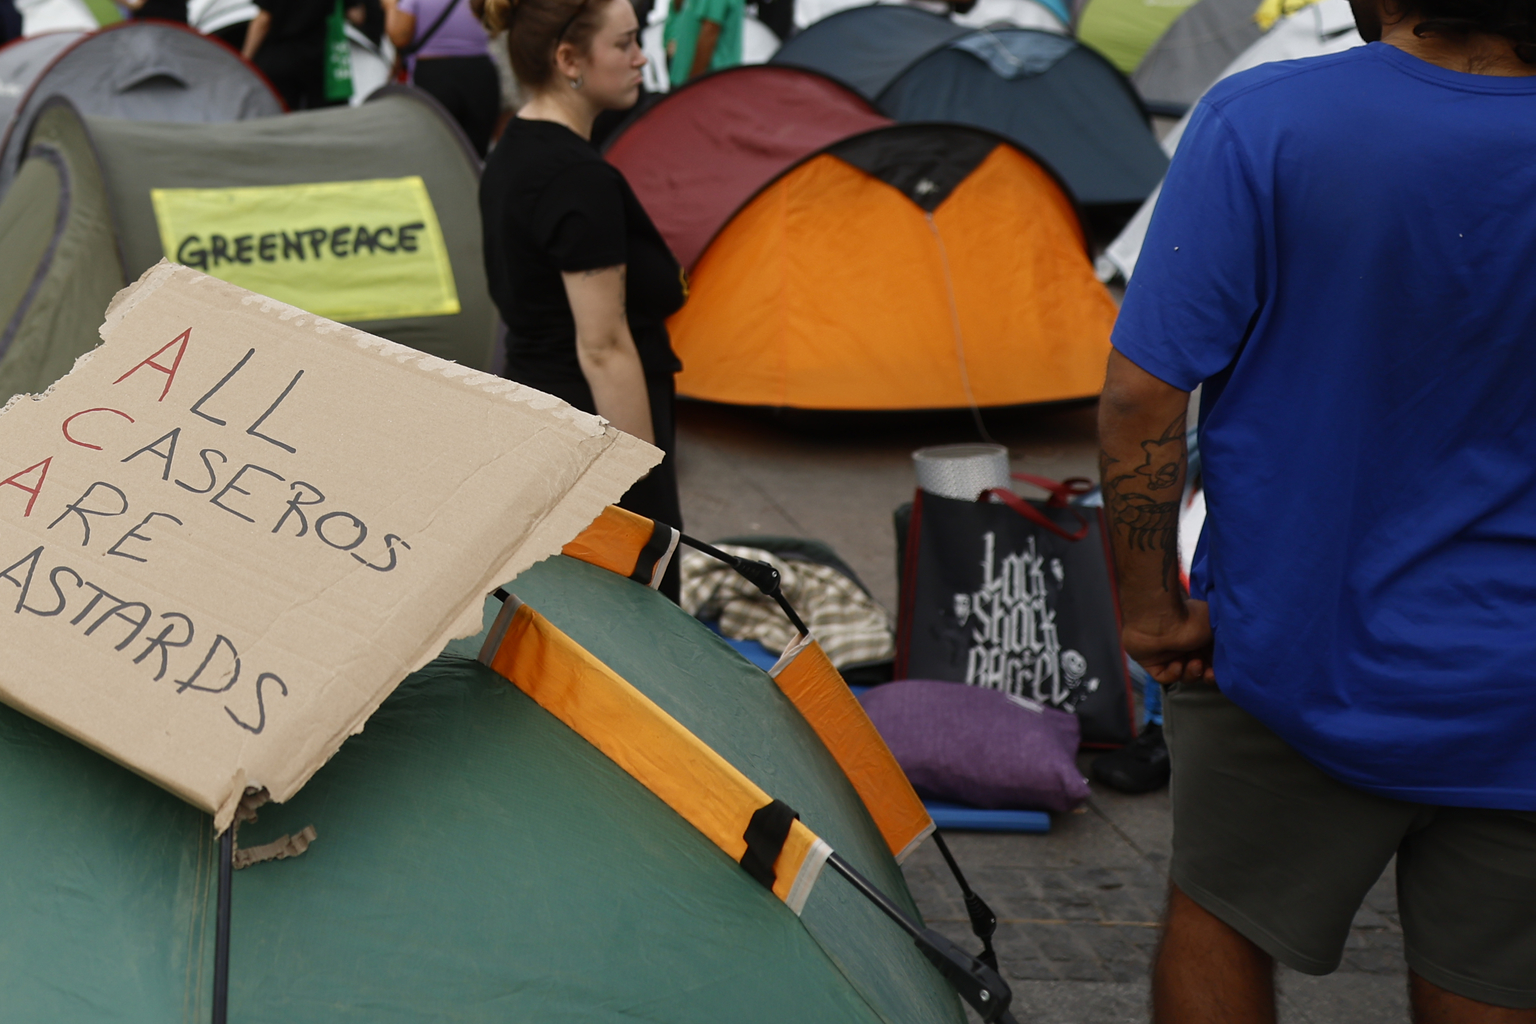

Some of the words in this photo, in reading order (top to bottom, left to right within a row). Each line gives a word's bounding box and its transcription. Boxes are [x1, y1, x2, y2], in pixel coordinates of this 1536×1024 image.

[175, 221, 425, 272] GREENPEACE
[112, 327, 306, 455] ALL
[62, 406, 412, 574] CASEROS
[980, 530, 1048, 608] Lock
